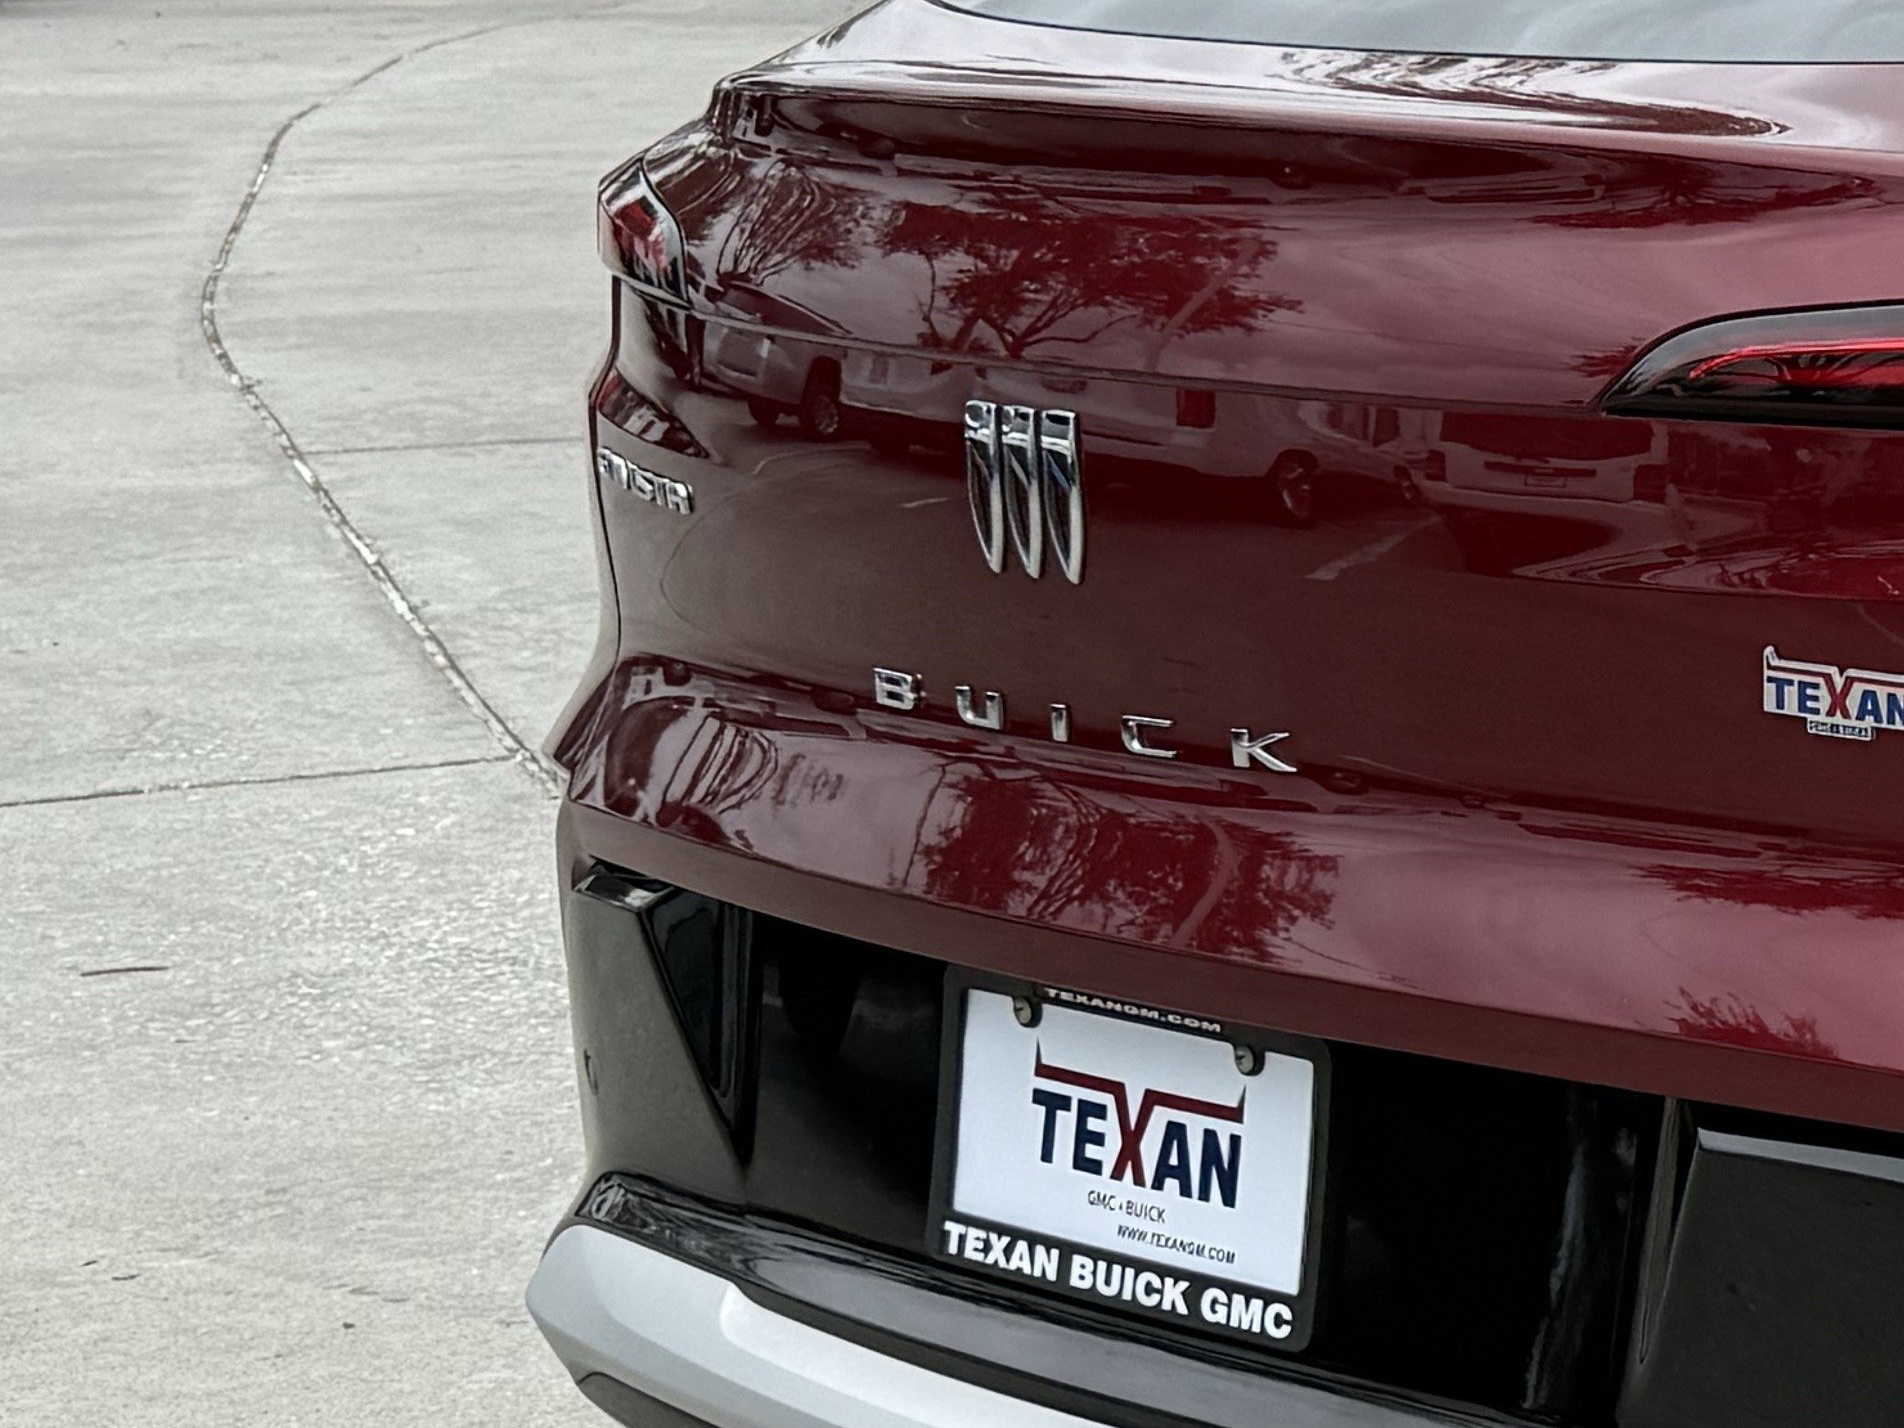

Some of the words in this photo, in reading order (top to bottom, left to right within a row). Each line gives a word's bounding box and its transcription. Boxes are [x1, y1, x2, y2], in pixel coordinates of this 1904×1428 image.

[873, 667, 1299, 773] BUICK
[1044, 987, 1222, 1033] TEXANGM.COM
[1031, 1071, 1244, 1209] TEXAN
[1125, 1199, 1166, 1224] BUICK
[943, 1220, 1060, 1282] TEXAN
[1069, 1253, 1191, 1315] BUICK
[1200, 1287, 1294, 1340] GMC
